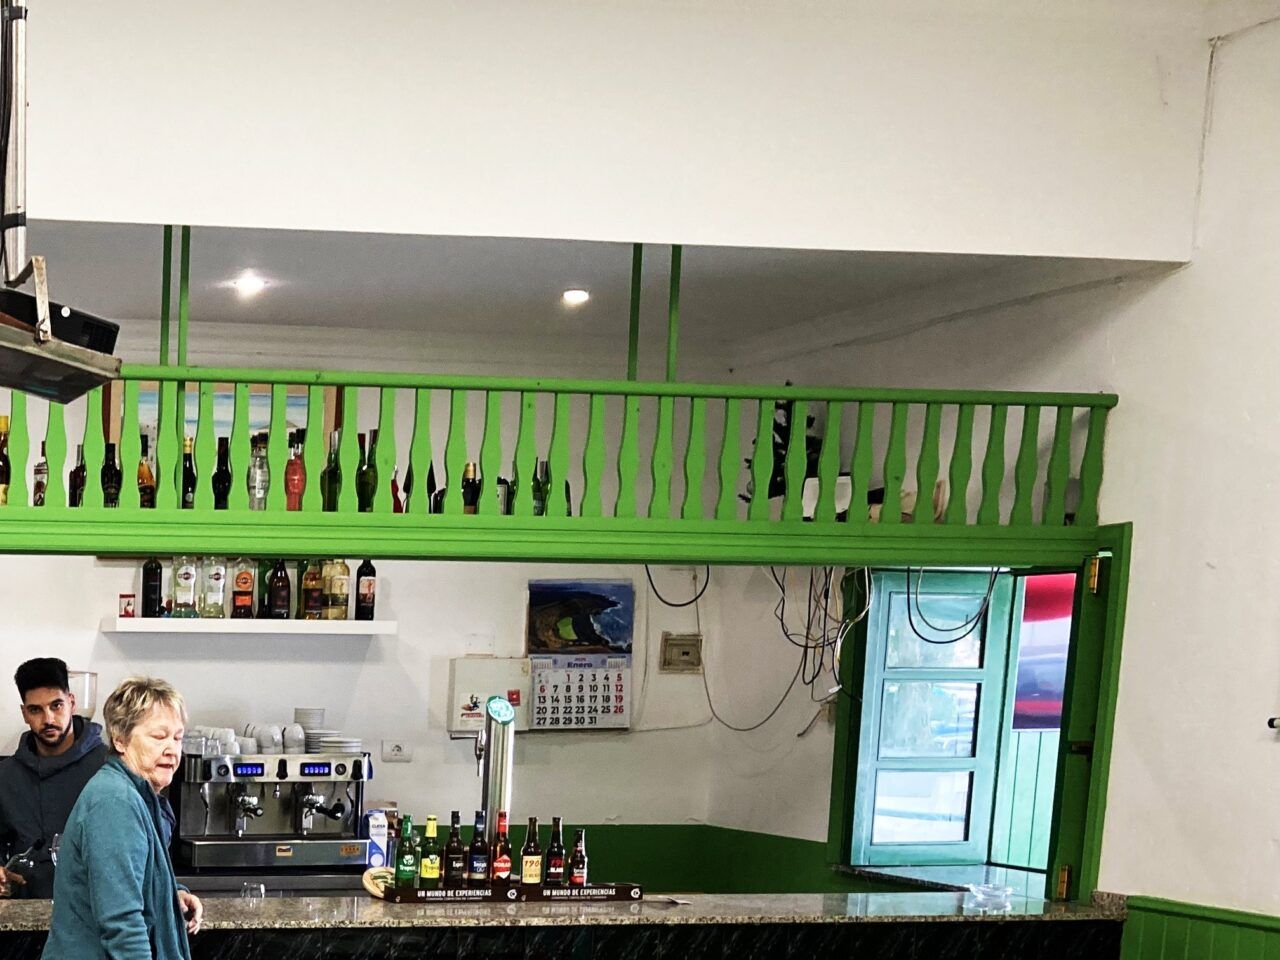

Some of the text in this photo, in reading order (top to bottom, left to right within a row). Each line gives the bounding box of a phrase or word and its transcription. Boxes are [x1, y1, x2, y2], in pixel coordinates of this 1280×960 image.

[447, 889, 454, 897] DE
[455, 889, 492, 897] EXPERIENCIAS
[571, 888, 579, 896] DE
[580, 888, 616, 896] EXPERIENCIAS
